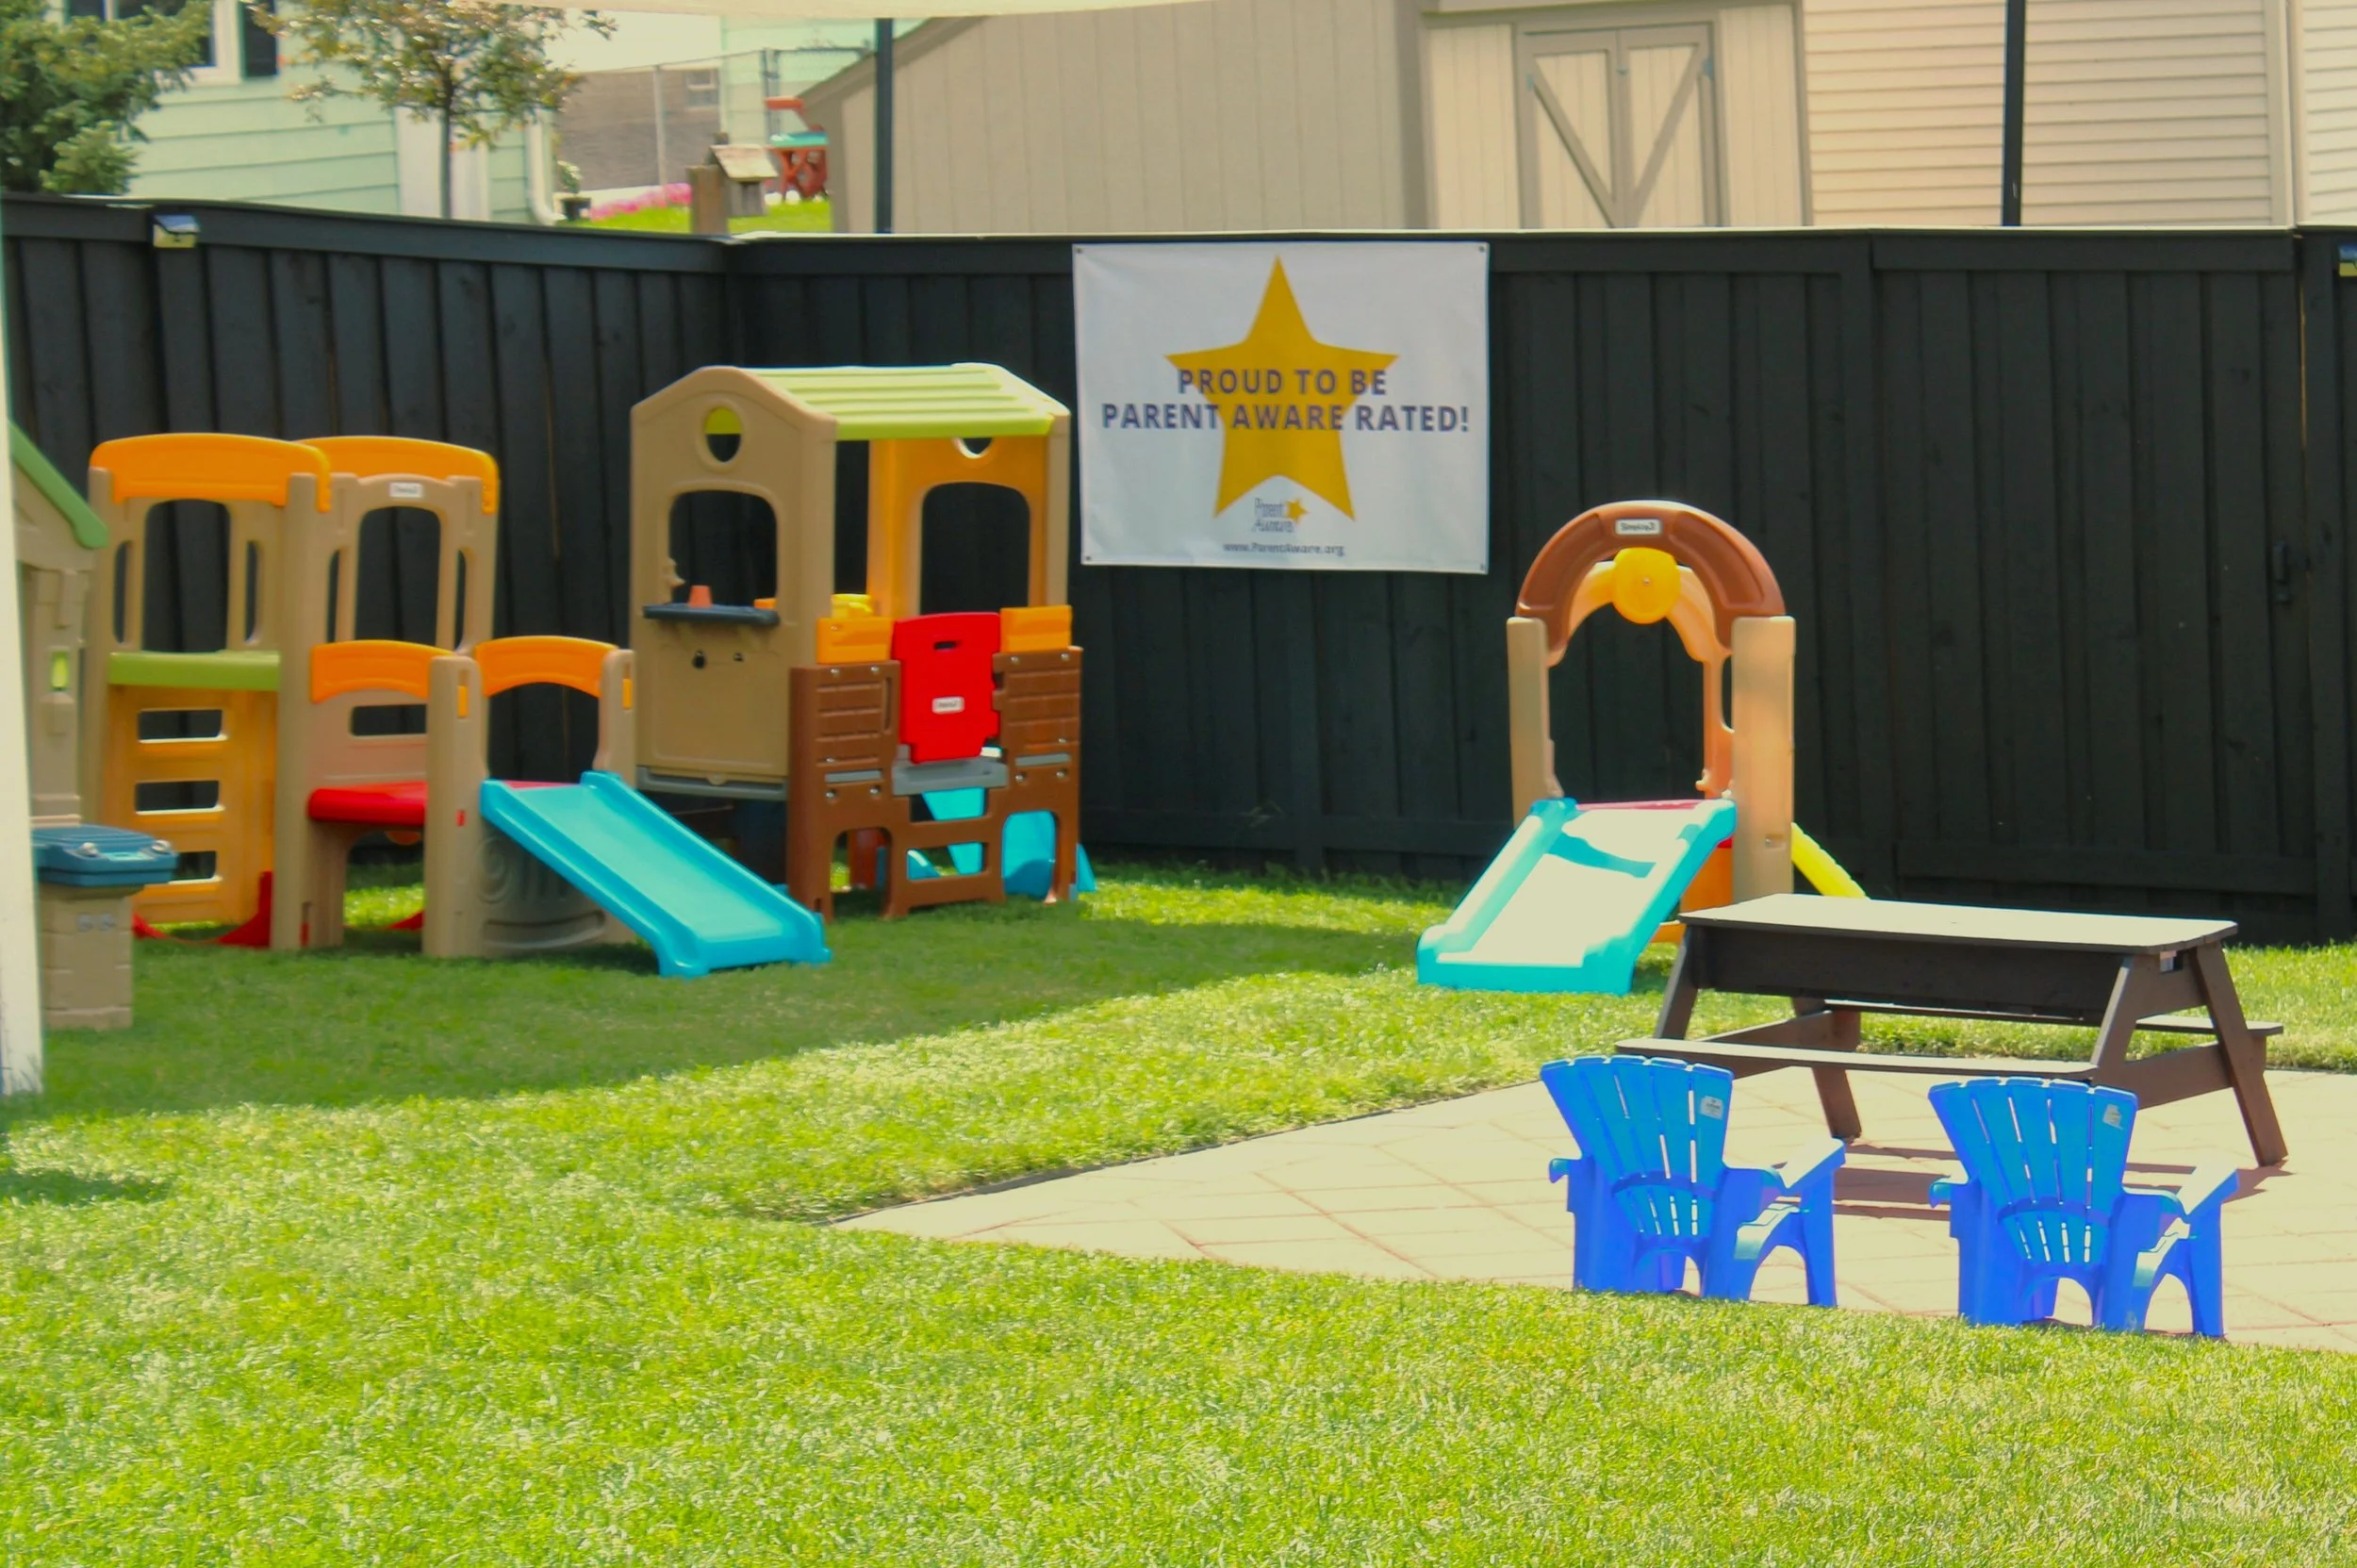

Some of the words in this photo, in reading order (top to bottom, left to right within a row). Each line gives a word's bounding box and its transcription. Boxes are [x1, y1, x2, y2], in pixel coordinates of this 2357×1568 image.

[1178, 369, 1283, 395] PROUD
[1295, 369, 1337, 395] TO
[1350, 369, 1387, 396] BE
[1101, 403, 1220, 430] PARENT
[1231, 404, 1344, 431] AWARE
[1355, 404, 1469, 433] RATED!
[1223, 541, 1345, 557] www.ParentAware.org
